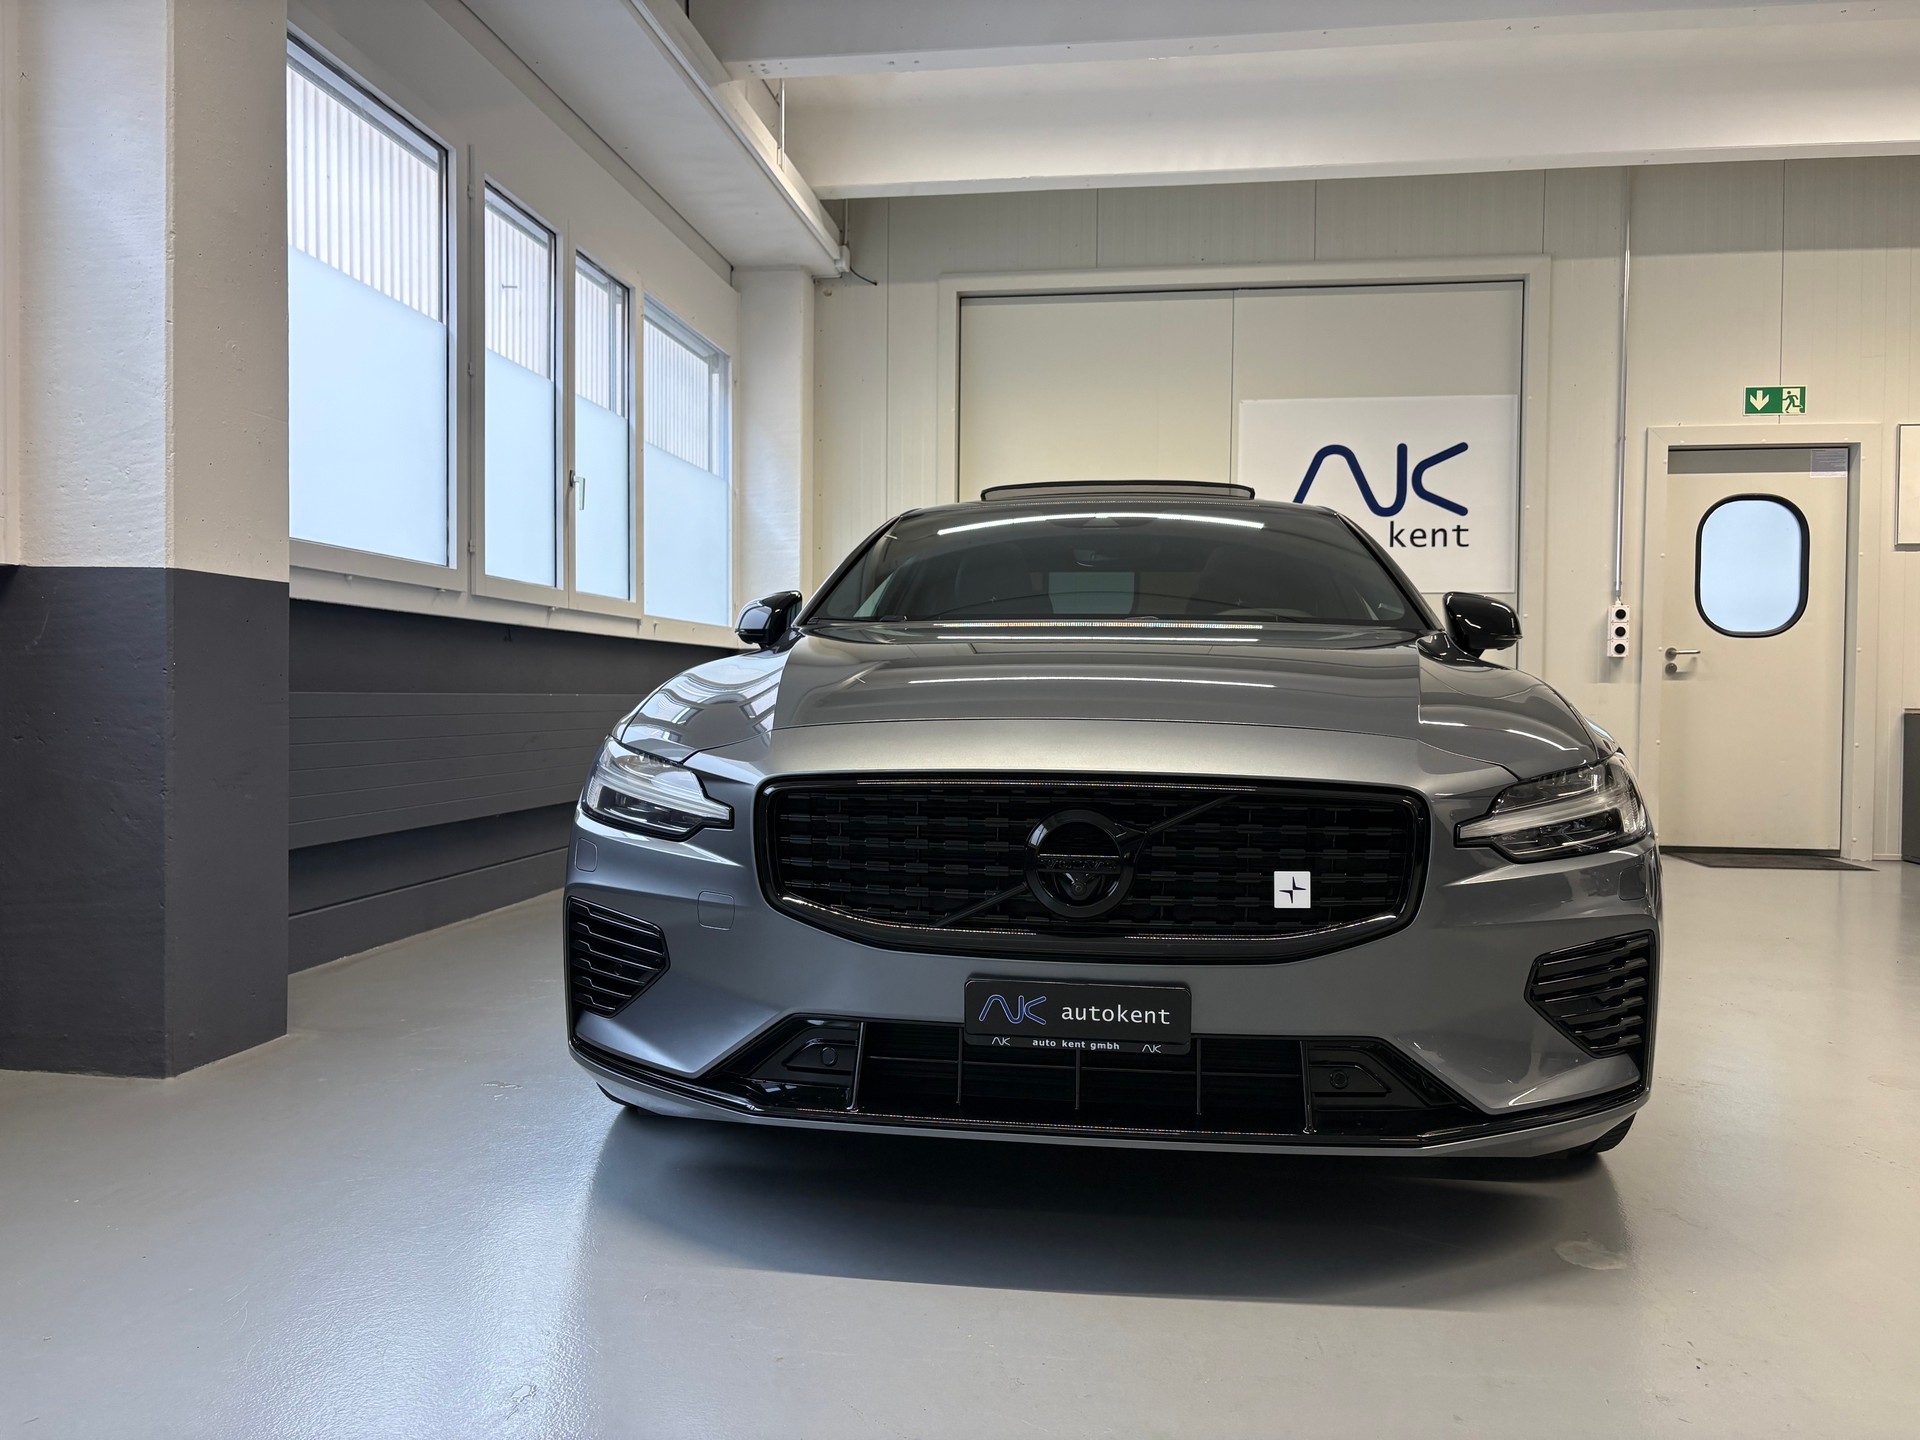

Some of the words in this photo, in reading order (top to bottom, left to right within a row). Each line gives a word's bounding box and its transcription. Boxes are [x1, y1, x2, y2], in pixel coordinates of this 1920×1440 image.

[1389, 520, 1469, 548] kent
[1061, 1004, 1171, 1025] autokent
[1032, 1039, 1056, 1047] auto
[1062, 1039, 1085, 1049] kent
[1090, 1041, 1120, 1051] gmbh
